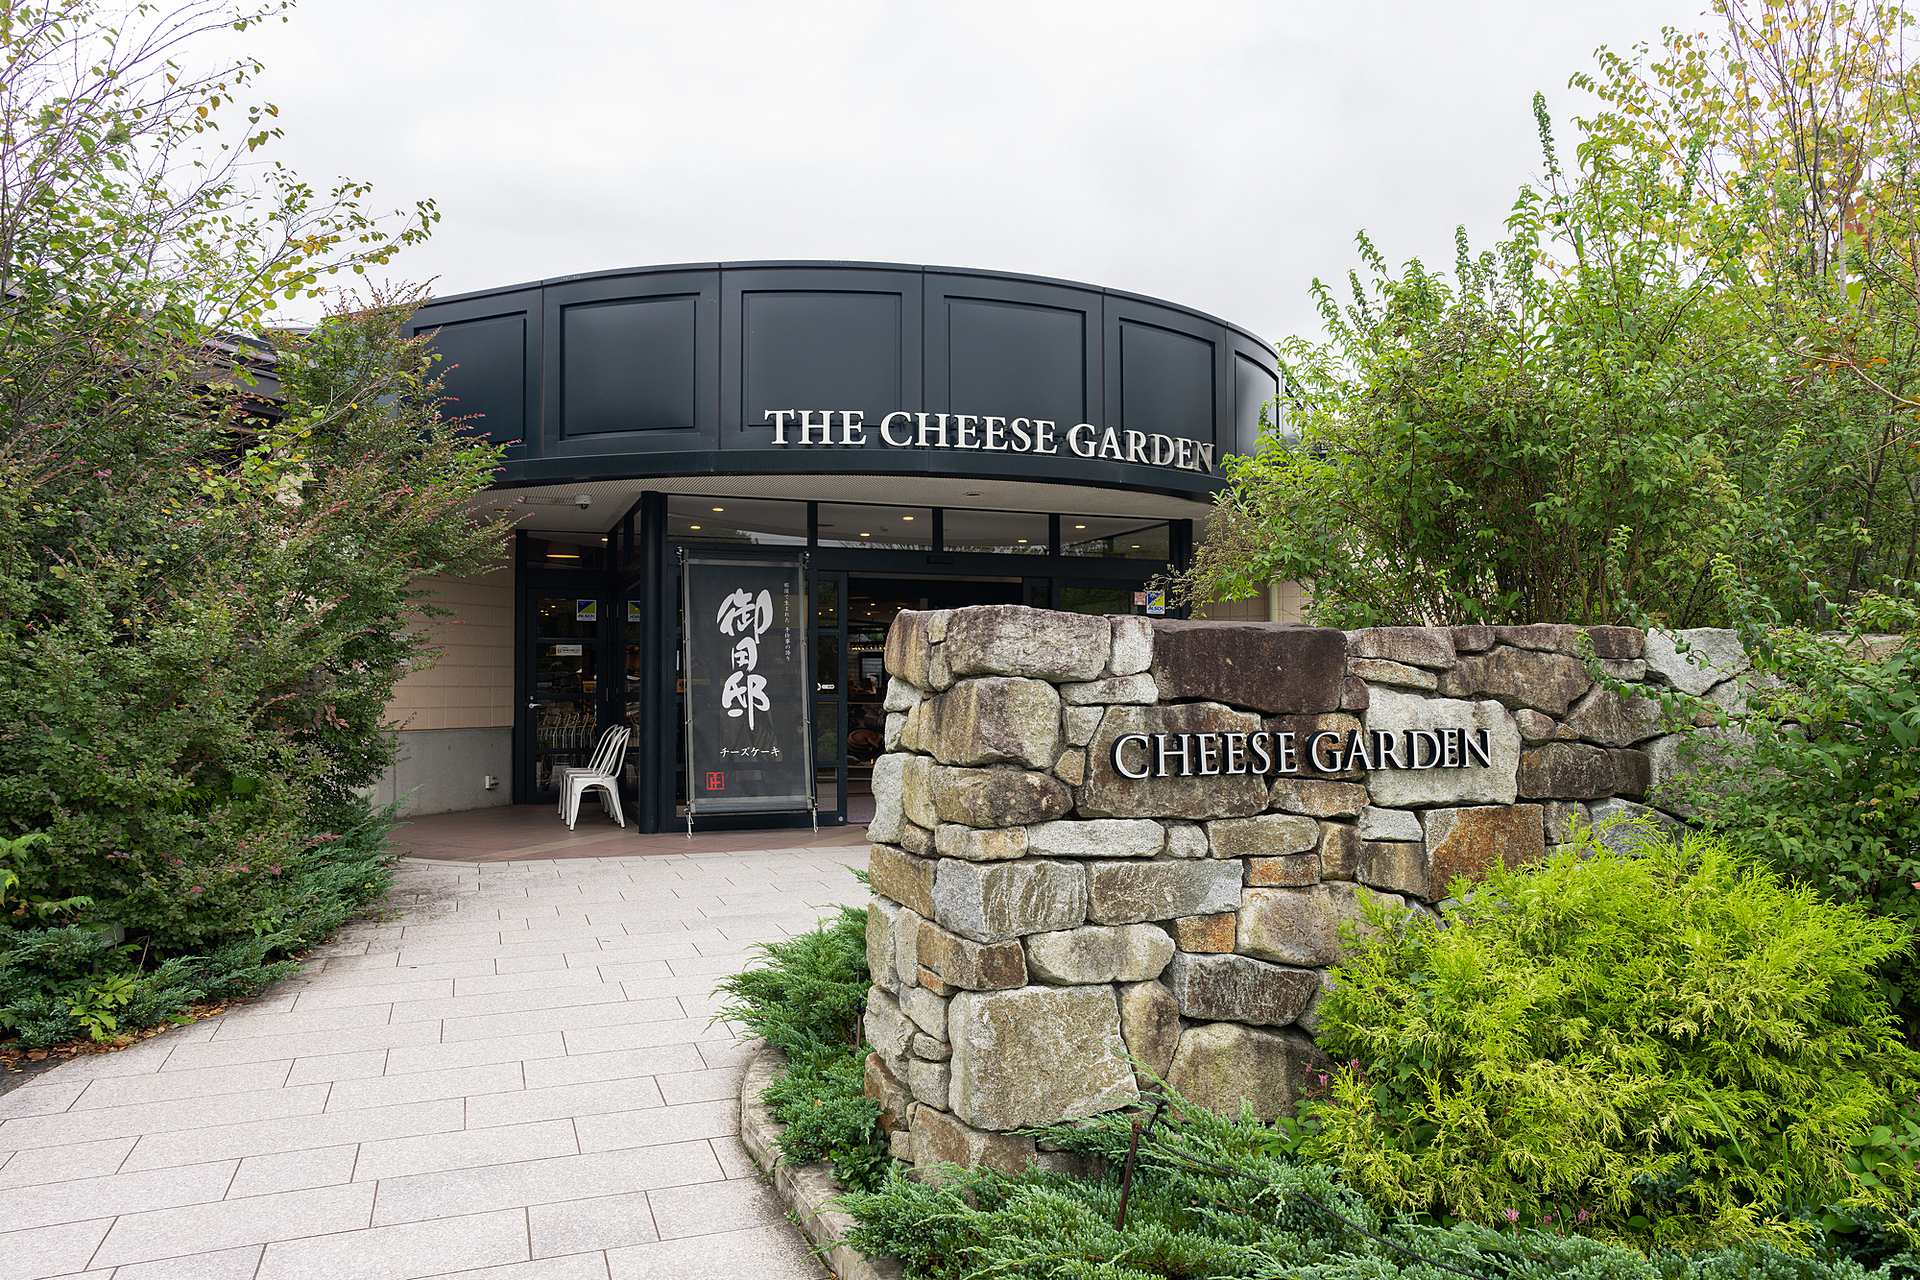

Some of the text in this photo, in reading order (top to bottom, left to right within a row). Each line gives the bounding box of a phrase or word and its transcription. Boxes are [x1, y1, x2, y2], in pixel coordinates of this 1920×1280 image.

[764, 409, 1215, 473] THE CHEESE GARDEN
[716, 588, 773, 731] 御用邸
[719, 746, 780, 758] チーズケーキ
[1110, 728, 1492, 779] CHEESE GARDEN
